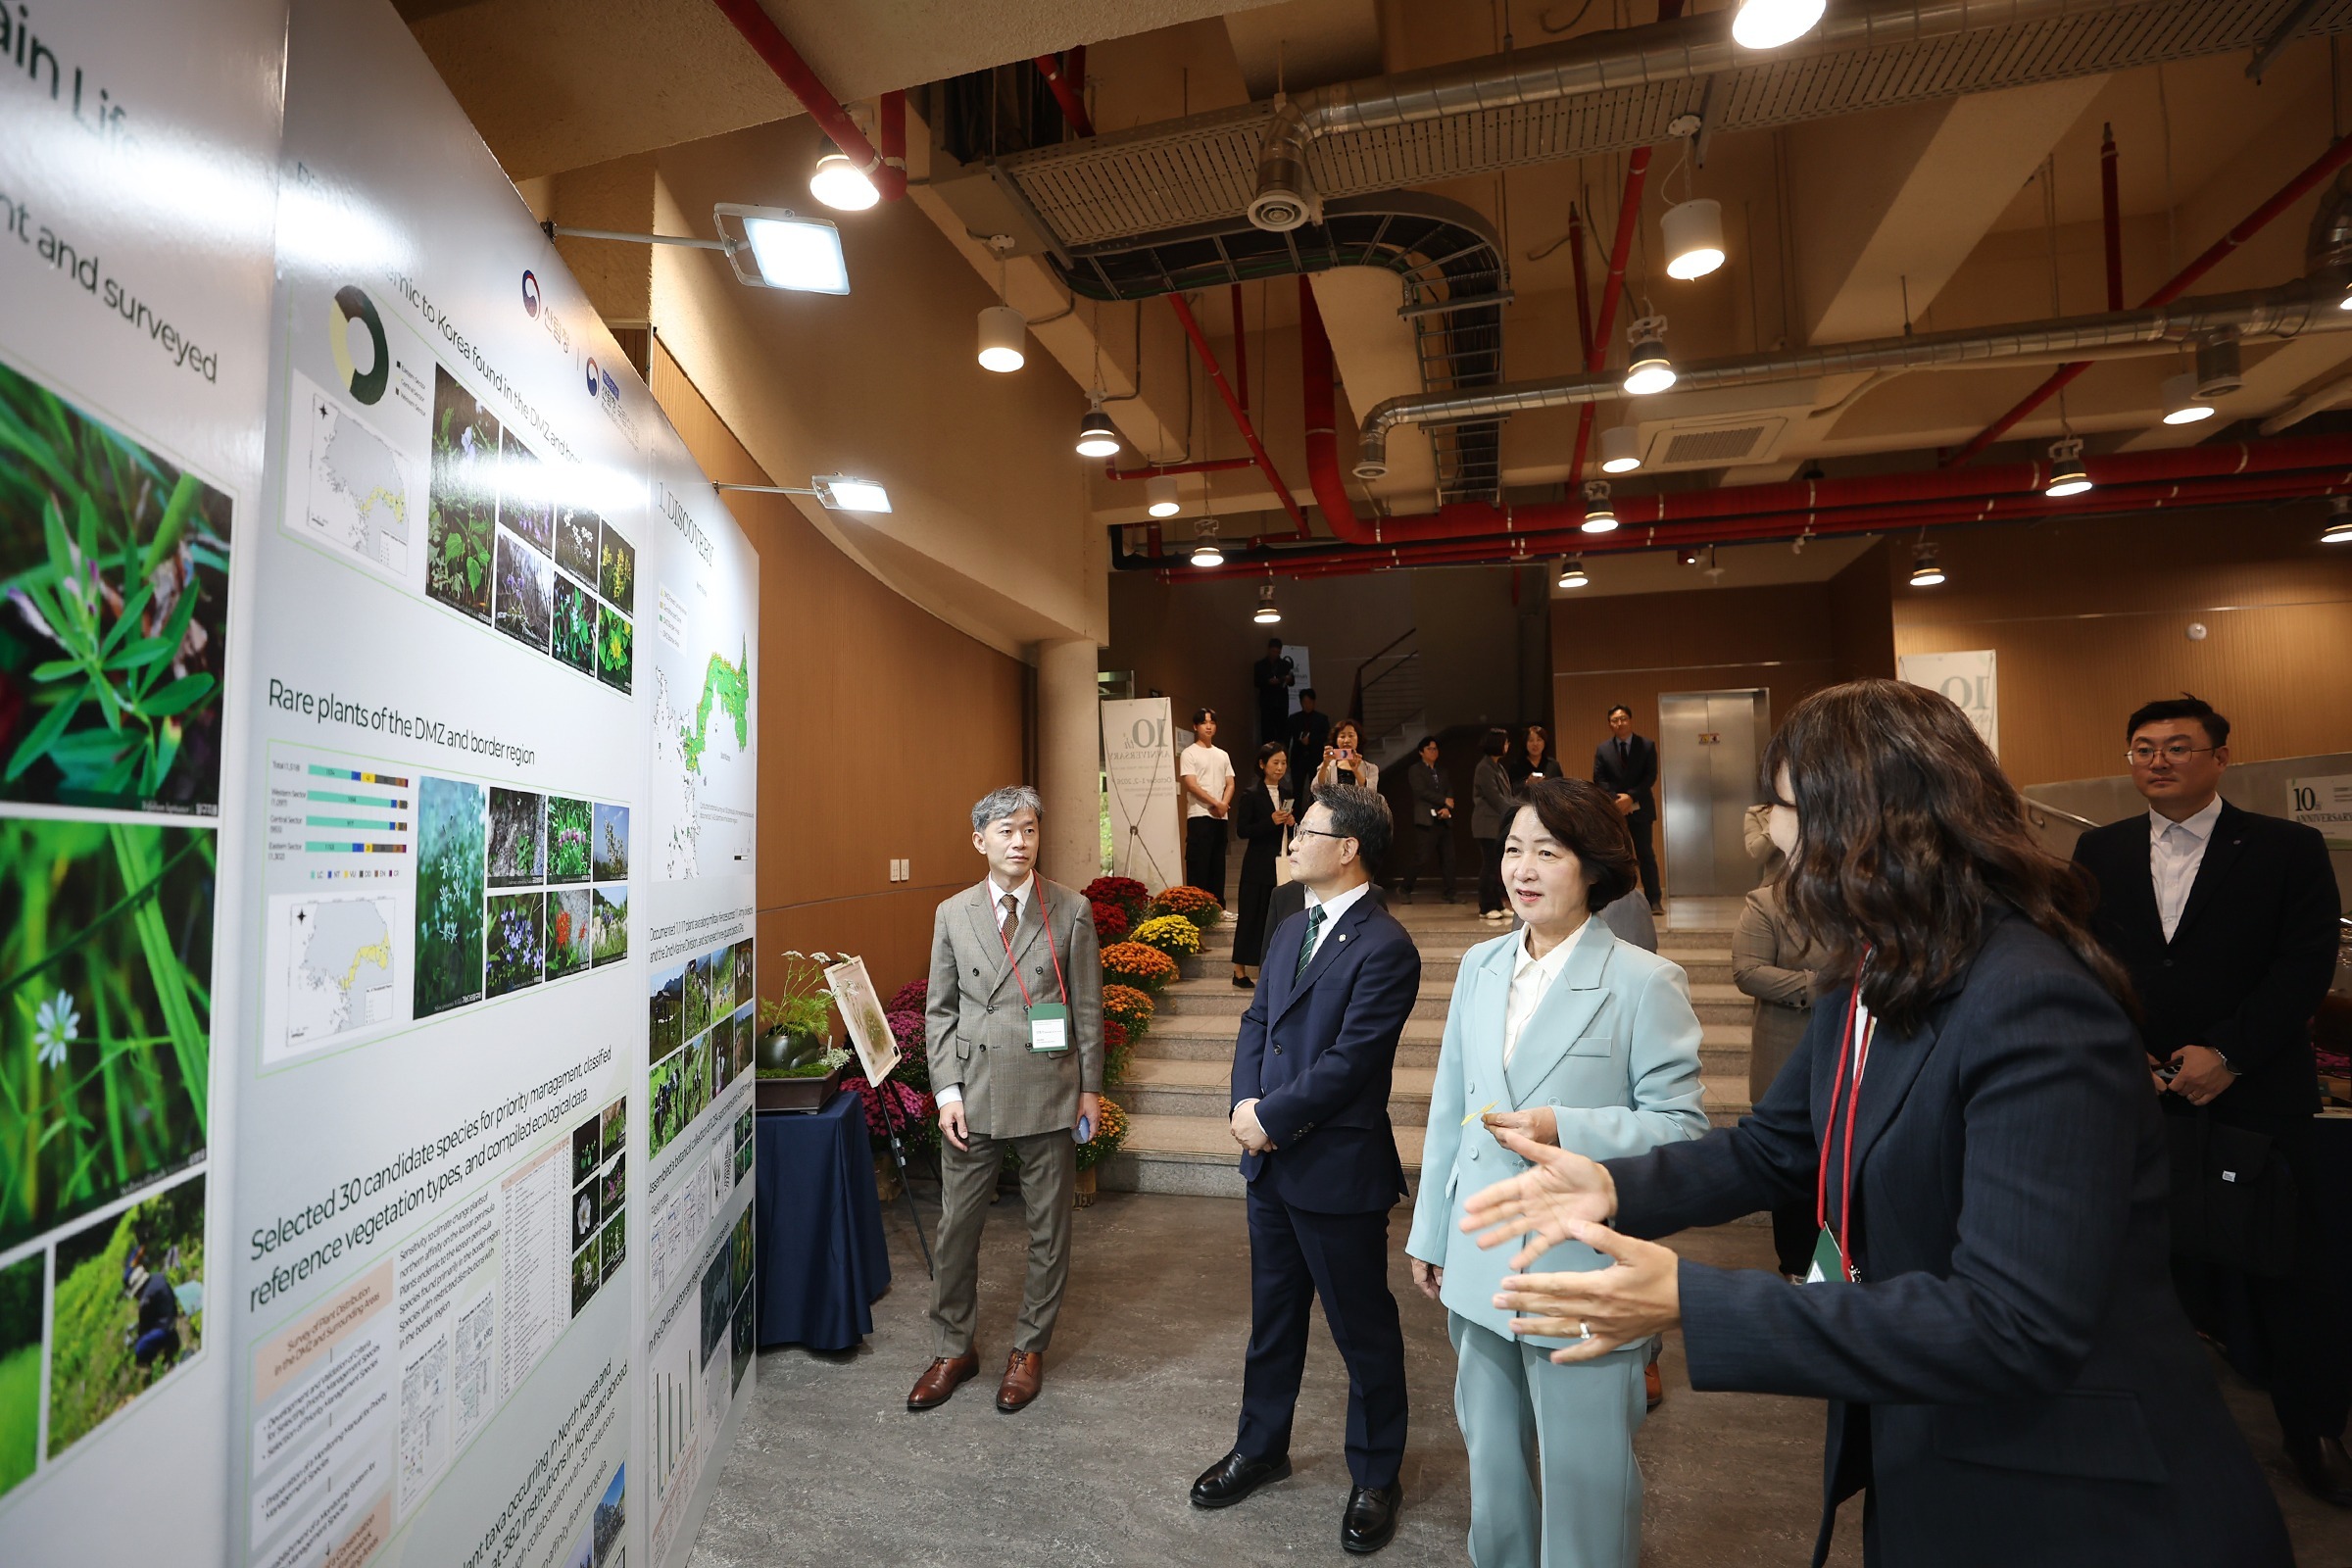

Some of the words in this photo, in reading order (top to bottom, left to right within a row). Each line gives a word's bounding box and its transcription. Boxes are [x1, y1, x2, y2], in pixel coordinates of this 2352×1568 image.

[37, 225, 97, 295] and
[103, 277, 218, 384] surveyed
[545, 306, 569, 354] 산림청
[422, 295, 435, 323] to
[438, 310, 470, 361] Korea
[471, 347, 503, 394] found
[504, 375, 514, 405] in
[514, 385, 530, 420] the
[529, 406, 550, 441] DMZ
[667, 490, 714, 567] DISCOVERY
[269, 678, 314, 715] Rare
[318, 692, 368, 728] plants
[371, 706, 388, 731] of
[388, 709, 413, 738] the
[415, 716, 445, 746] DMZ
[447, 726, 468, 752] and
[470, 730, 505, 759] border
[506, 739, 535, 766] region
[650, 922, 676, 942] Documented
[251, 1189, 335, 1261] Selected
[339, 1178, 362, 1211] 30
[364, 1144, 434, 1197] candidate
[436, 1119, 478, 1159] species
[480, 1110, 494, 1131] for
[496, 1092, 529, 1129] priority
[530, 1063, 583, 1105] management,
[584, 1045, 612, 1074] classified
[250, 1238, 343, 1313] reference
[345, 1187, 424, 1250] vegetation
[427, 1165, 463, 1202] types,
[465, 1144, 485, 1176] and
[487, 1117, 531, 1161] compiled
[532, 1094, 571, 1132] ecological
[400, 1278, 416, 1297] Plants
[417, 1260, 440, 1283] endemic
[440, 1255, 446, 1266] to
[471, 1220, 492, 1243] peninsula
[400, 1292, 420, 1314] Species
[420, 1277, 436, 1297] found
[437, 1260, 458, 1287] primarily
[472, 1238, 487, 1255] border
[487, 1229, 500, 1244] region
[400, 1309, 420, 1333] Species
[421, 1298, 432, 1315] with
[434, 1276, 457, 1304] restricted
[457, 1257, 484, 1284] distributions
[485, 1247, 494, 1261] with
[485, 1511, 507, 1550] taxa
[508, 1449, 549, 1518] occurring
[550, 1438, 558, 1458] in
[558, 1407, 578, 1447] North
[579, 1381, 599, 1415] Korea
[599, 1357, 611, 1387] and
[503, 1517, 520, 1559] 382
[522, 1455, 566, 1530] institutions
[566, 1443, 574, 1466] in
[575, 1413, 594, 1450] Korea
[594, 1393, 607, 1423] and
[607, 1358, 627, 1398] abroad
[527, 1481, 567, 1552] collaboration
[567, 1460, 581, 1488] with
[581, 1447, 588, 1469] 32
